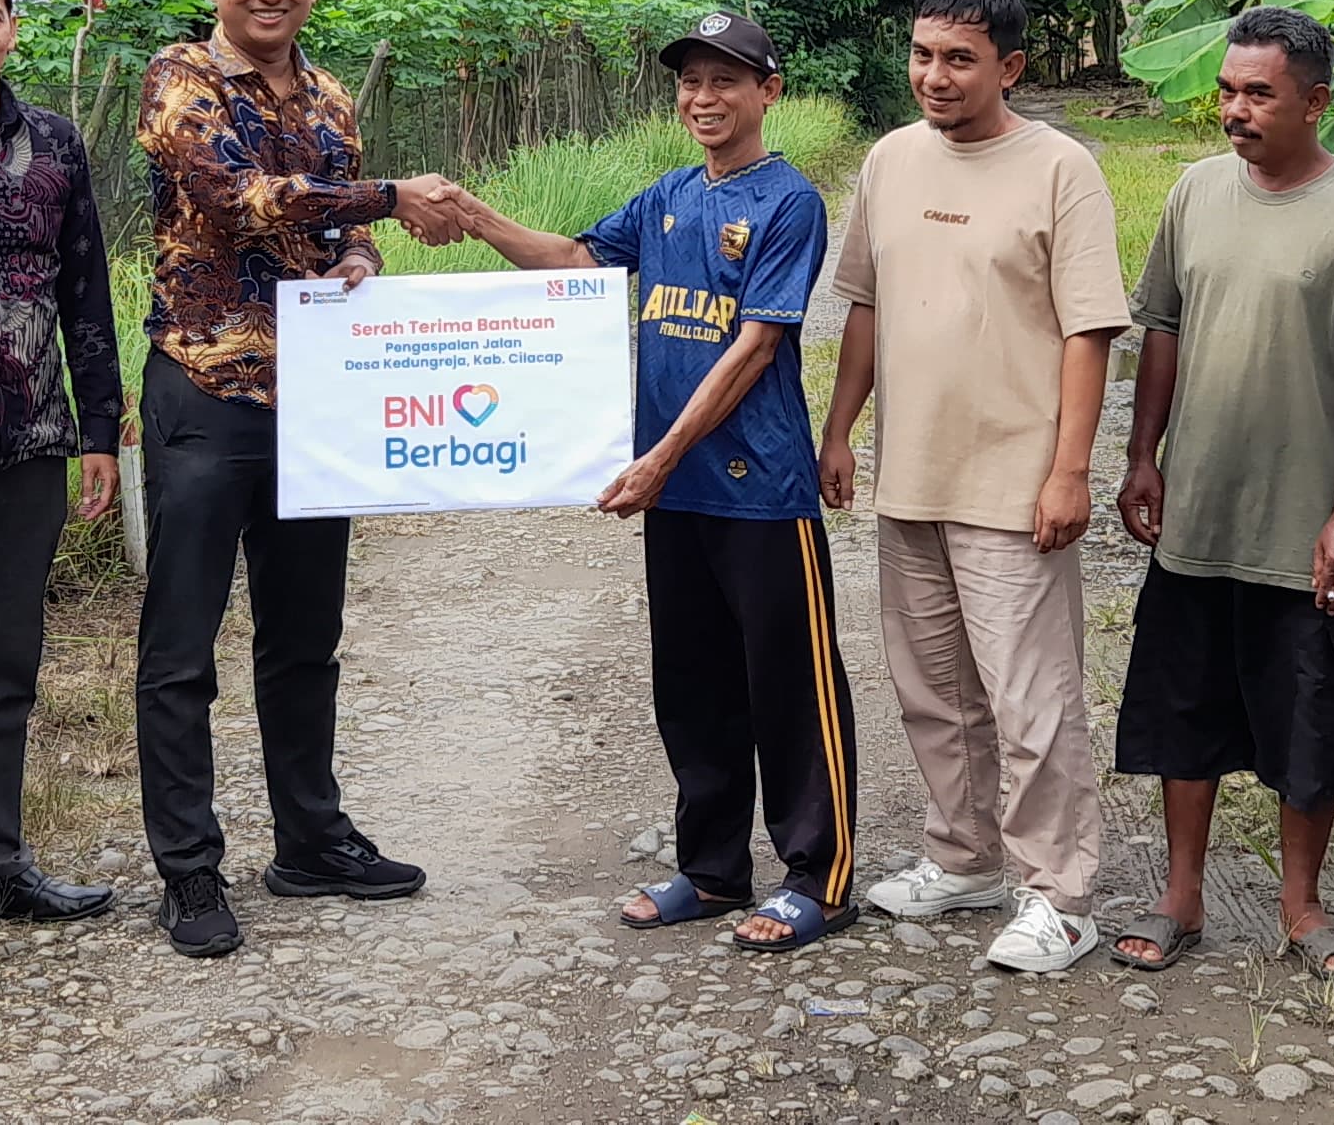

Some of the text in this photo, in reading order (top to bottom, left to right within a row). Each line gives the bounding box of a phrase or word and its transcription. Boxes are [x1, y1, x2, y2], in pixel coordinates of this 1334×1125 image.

[567, 278, 605, 296] BNI
[351, 316, 555, 337] Serah Terima Bantuan
[693, 326, 721, 343] CLUB
[385, 337, 522, 355] Pengaspalan Jalan
[345, 351, 564, 371] Desa Kedungreja, Kab. Cilacap
[384, 394, 444, 428] BNI
[385, 432, 527, 474] Berbagi
